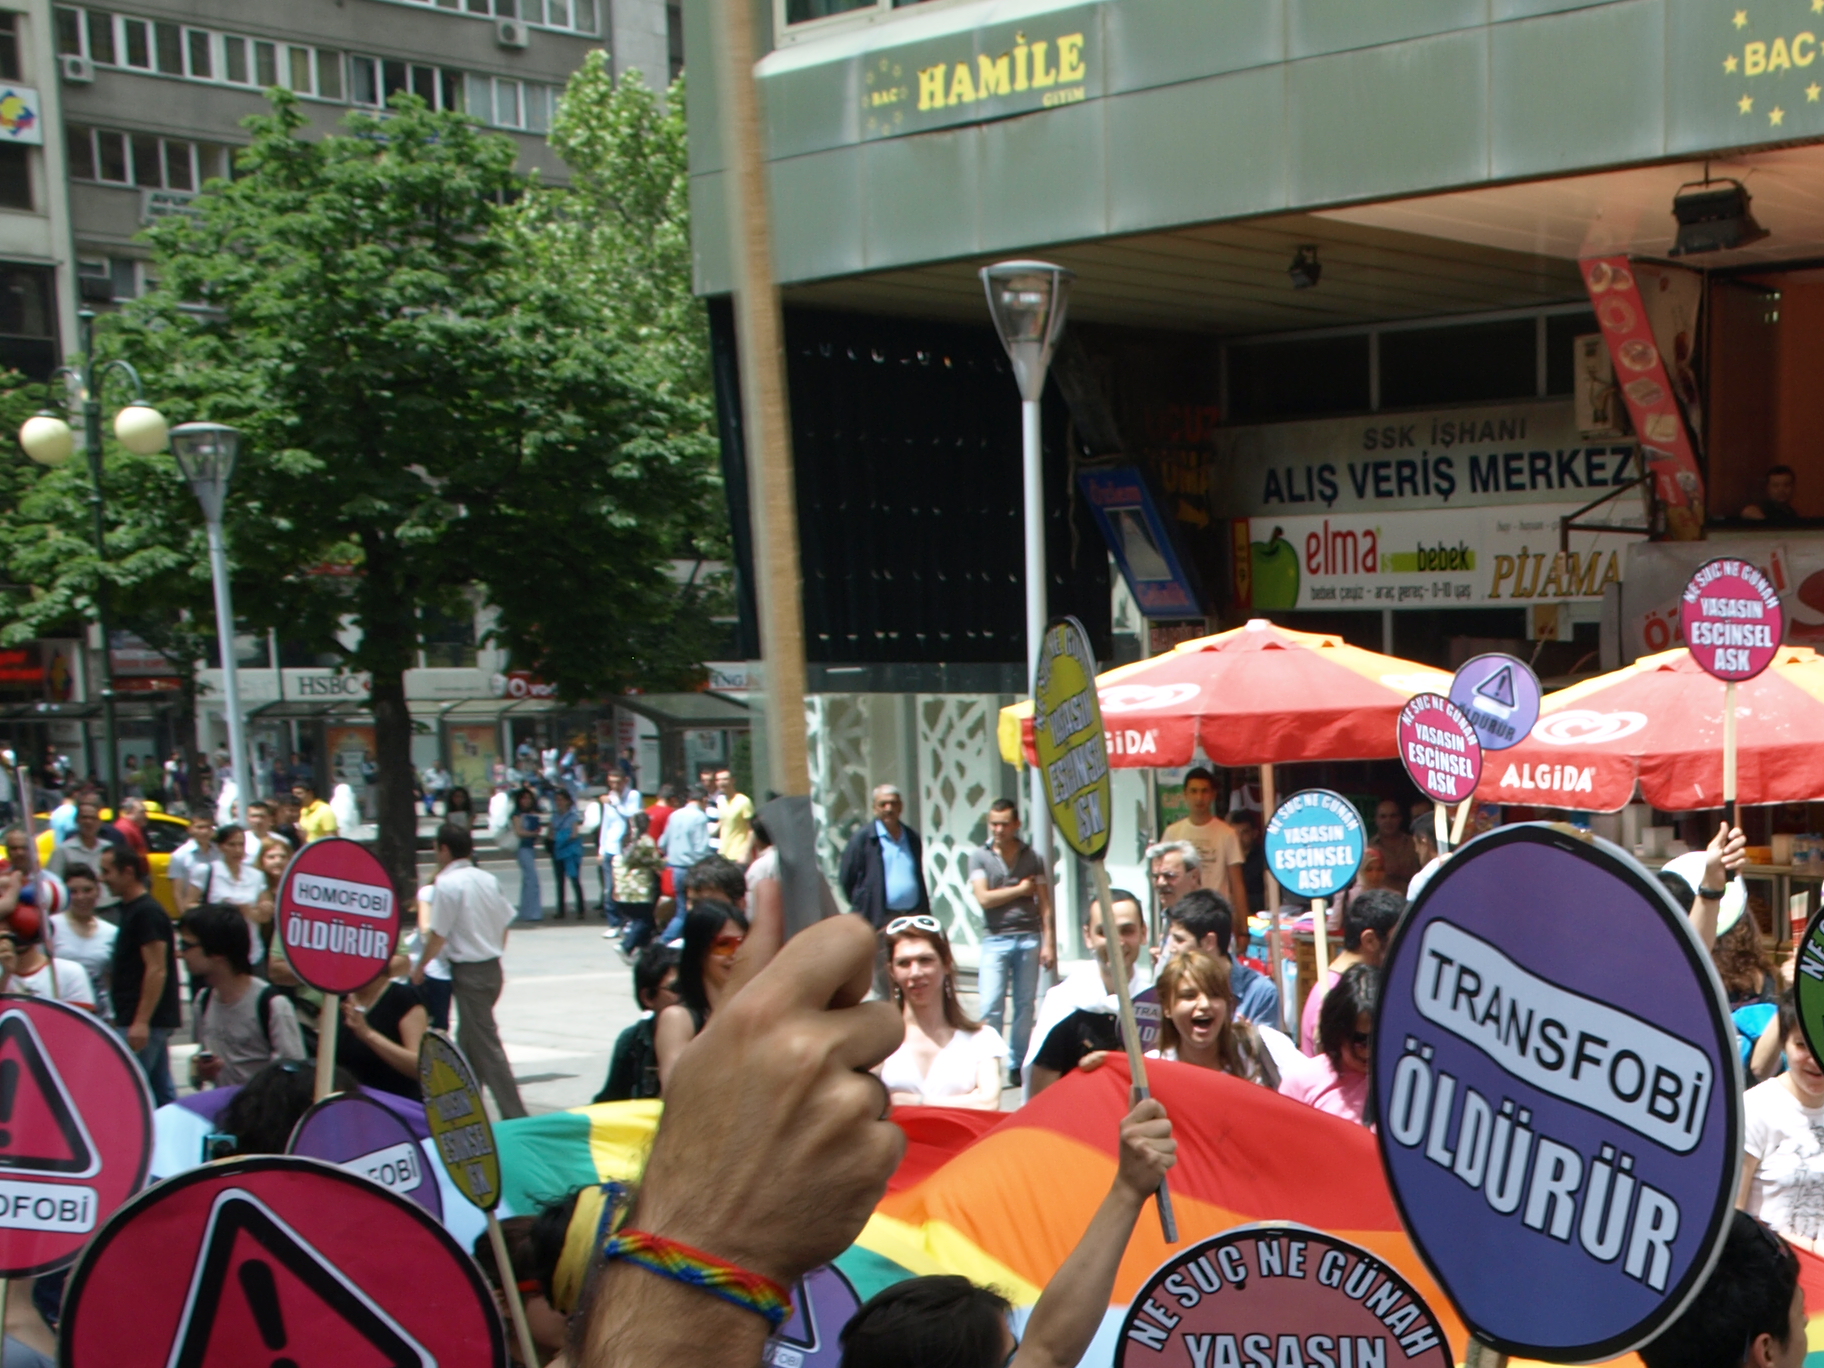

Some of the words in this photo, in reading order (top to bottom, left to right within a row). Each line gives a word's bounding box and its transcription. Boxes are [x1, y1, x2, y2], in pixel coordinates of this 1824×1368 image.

[917, 31, 1085, 111] HAMİLE
[1745, 32, 1815, 76] BAC
[1363, 426, 1415, 451] SSK
[1430, 417, 1527, 450] İŞHANI
[1263, 462, 1339, 508] ALIŞ
[1348, 450, 1456, 502] VERİŞ
[1305, 519, 1377, 576] elma
[1416, 539, 1471, 572] bebek
[1487, 545, 1620, 599] PİJAMA
[298, 675, 359, 695] HSBC
[298, 882, 389, 913] HOMOFOBİ
[286, 911, 390, 961] ÖLDÜRÜR
[1428, 948, 1705, 1135] TRANSFOBİ
[367, 1150, 418, 1186] FOBİ
[1388, 1033, 1682, 1296] ÖLDÜRÜR
[1126, 1297, 1182, 1352] NE
[1163, 1244, 1248, 1309] SUÇ
[1256, 1238, 1307, 1279] NE
[1316, 1247, 1441, 1360] GÜNAH
